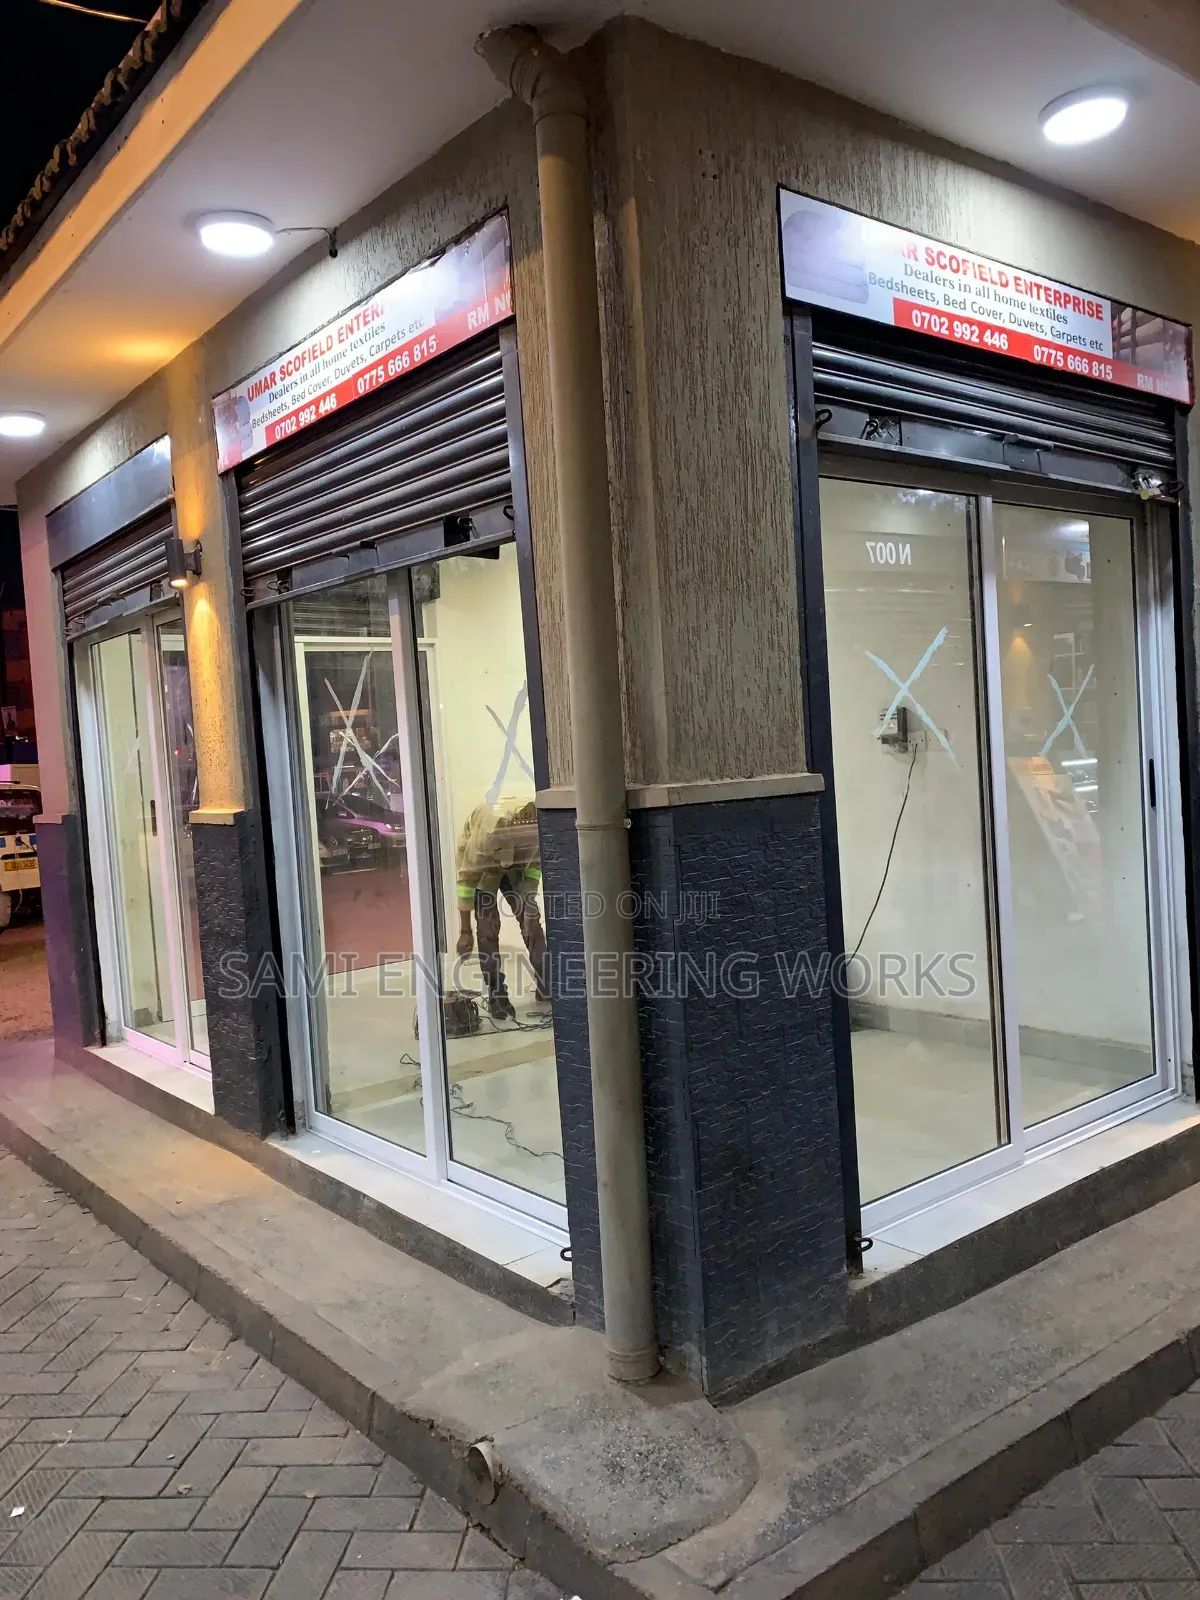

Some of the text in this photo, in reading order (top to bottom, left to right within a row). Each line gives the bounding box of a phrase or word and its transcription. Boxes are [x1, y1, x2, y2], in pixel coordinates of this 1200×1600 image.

[868, 271, 1104, 352] Bedsheets, Bed Cover, Duvets, Carpets etc
[903, 262, 1068, 325] Dealers in all home textiles
[924, 246, 1010, 288] SCOFIELD
[1013, 275, 1104, 321] ENTERPRISE
[247, 371, 277, 402] UMAR
[279, 334, 334, 382] SCOFIELD
[251, 316, 425, 429] Bedsheets, Bed Cover, Duvets, Carpets etc
[268, 322, 386, 404] Dealers in all home textiles
[275, 415, 297, 440] 0702
[298, 405, 317, 427] 992
[318, 393, 337, 415] 446
[356, 365, 385, 394] 0775
[387, 350, 411, 377] 666
[413, 334, 438, 362] 815
[467, 302, 490, 331] RM
[911, 309, 950, 335] 0702
[953, 320, 980, 343] 992
[983, 328, 1009, 350] 446
[1033, 344, 1064, 367] 0775
[1067, 354, 1089, 374] 666
[1092, 360, 1113, 380] 815
[1136, 372, 1154, 391] RM
